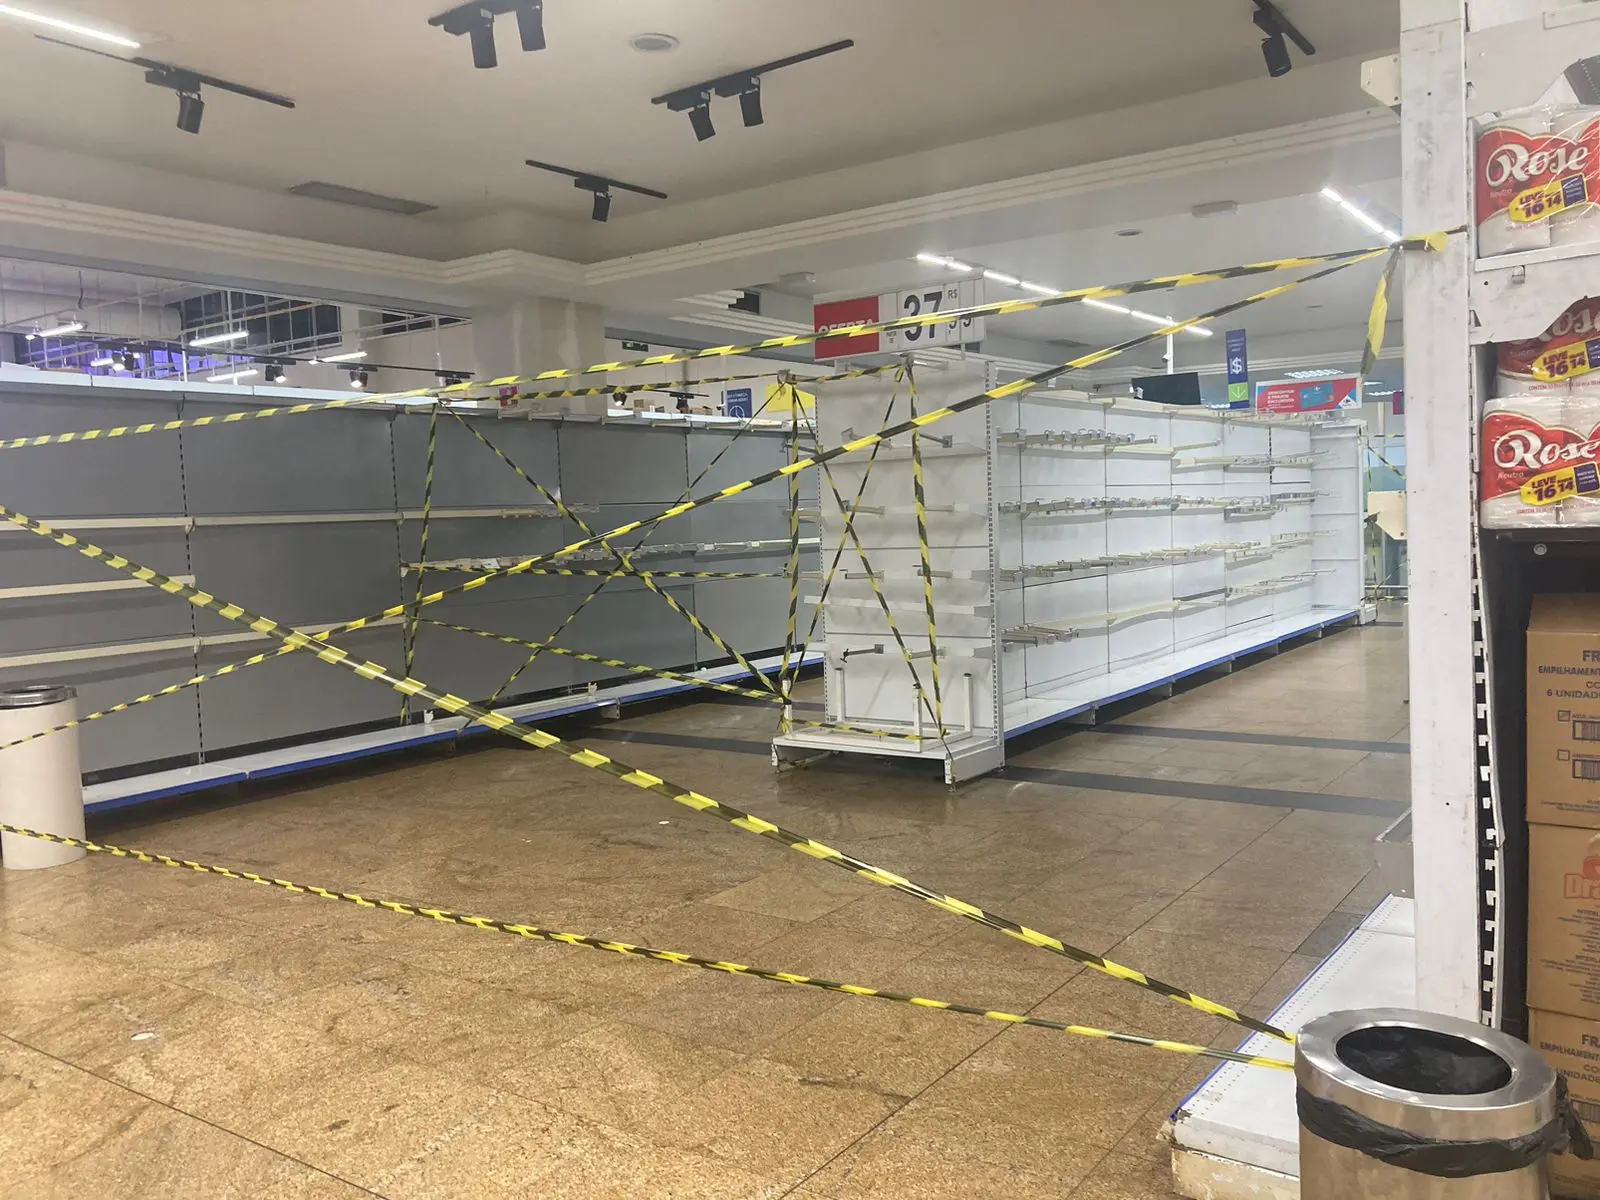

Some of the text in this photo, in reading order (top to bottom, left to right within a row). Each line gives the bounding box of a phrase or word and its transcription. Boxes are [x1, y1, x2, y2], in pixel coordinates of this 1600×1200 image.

[1486, 144, 1589, 187] Rose
[904, 291, 943, 342] 37
[1543, 350, 1568, 366] LEVE
[1546, 361, 1569, 379] 16
[1494, 429, 1600, 469] Rose
[1531, 475, 1557, 489] LEVE
[1534, 484, 1557, 501] 16
[1558, 480, 1574, 492] 14
[1547, 689, 1553, 697] 6
